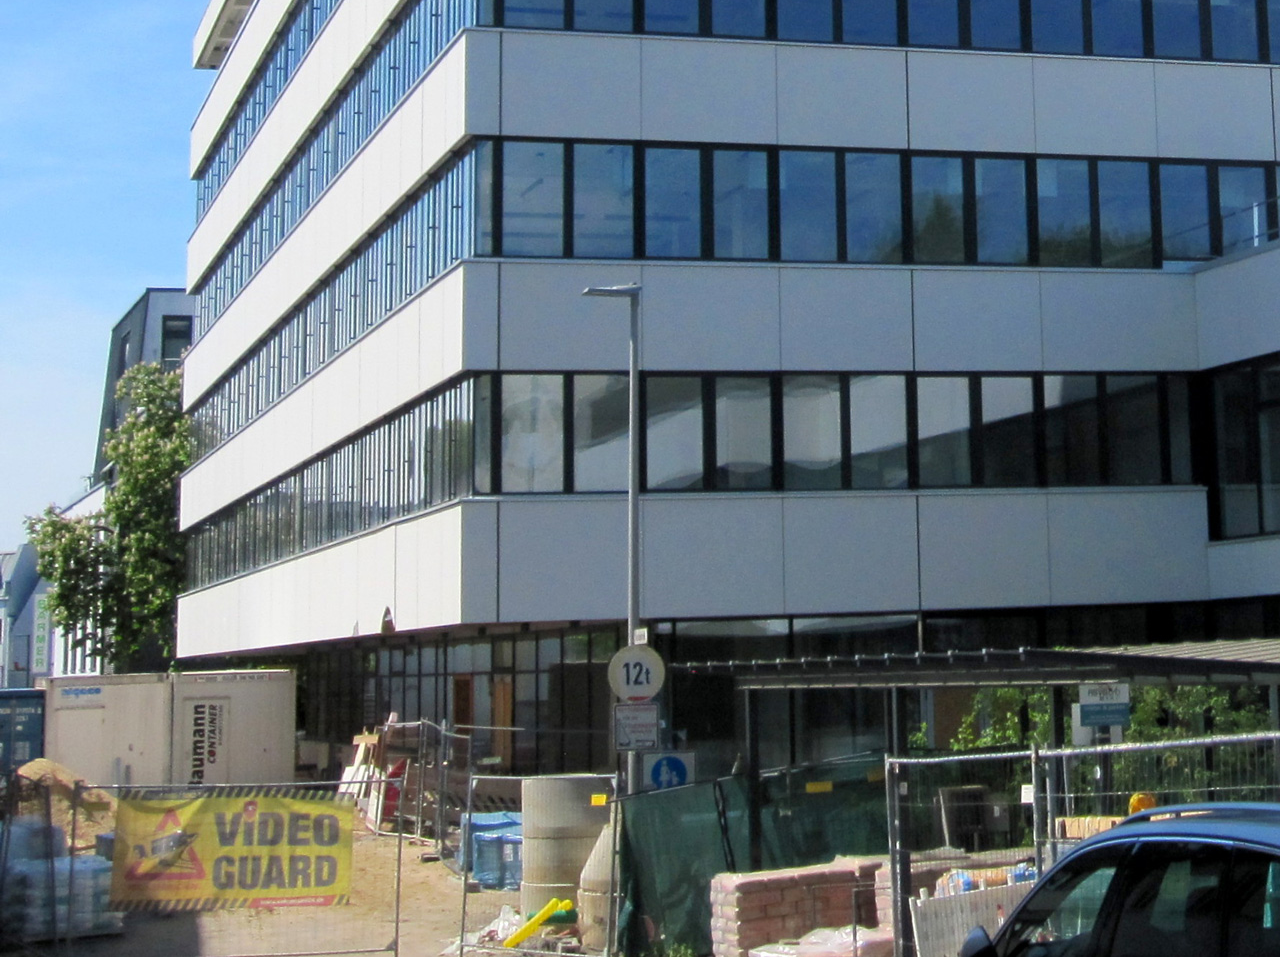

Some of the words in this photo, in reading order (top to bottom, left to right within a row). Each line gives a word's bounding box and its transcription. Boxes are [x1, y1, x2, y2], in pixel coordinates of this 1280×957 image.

[622, 661, 651, 685] 12t
[207, 704, 218, 764] CONTAINER
[212, 854, 338, 890] GUARD
